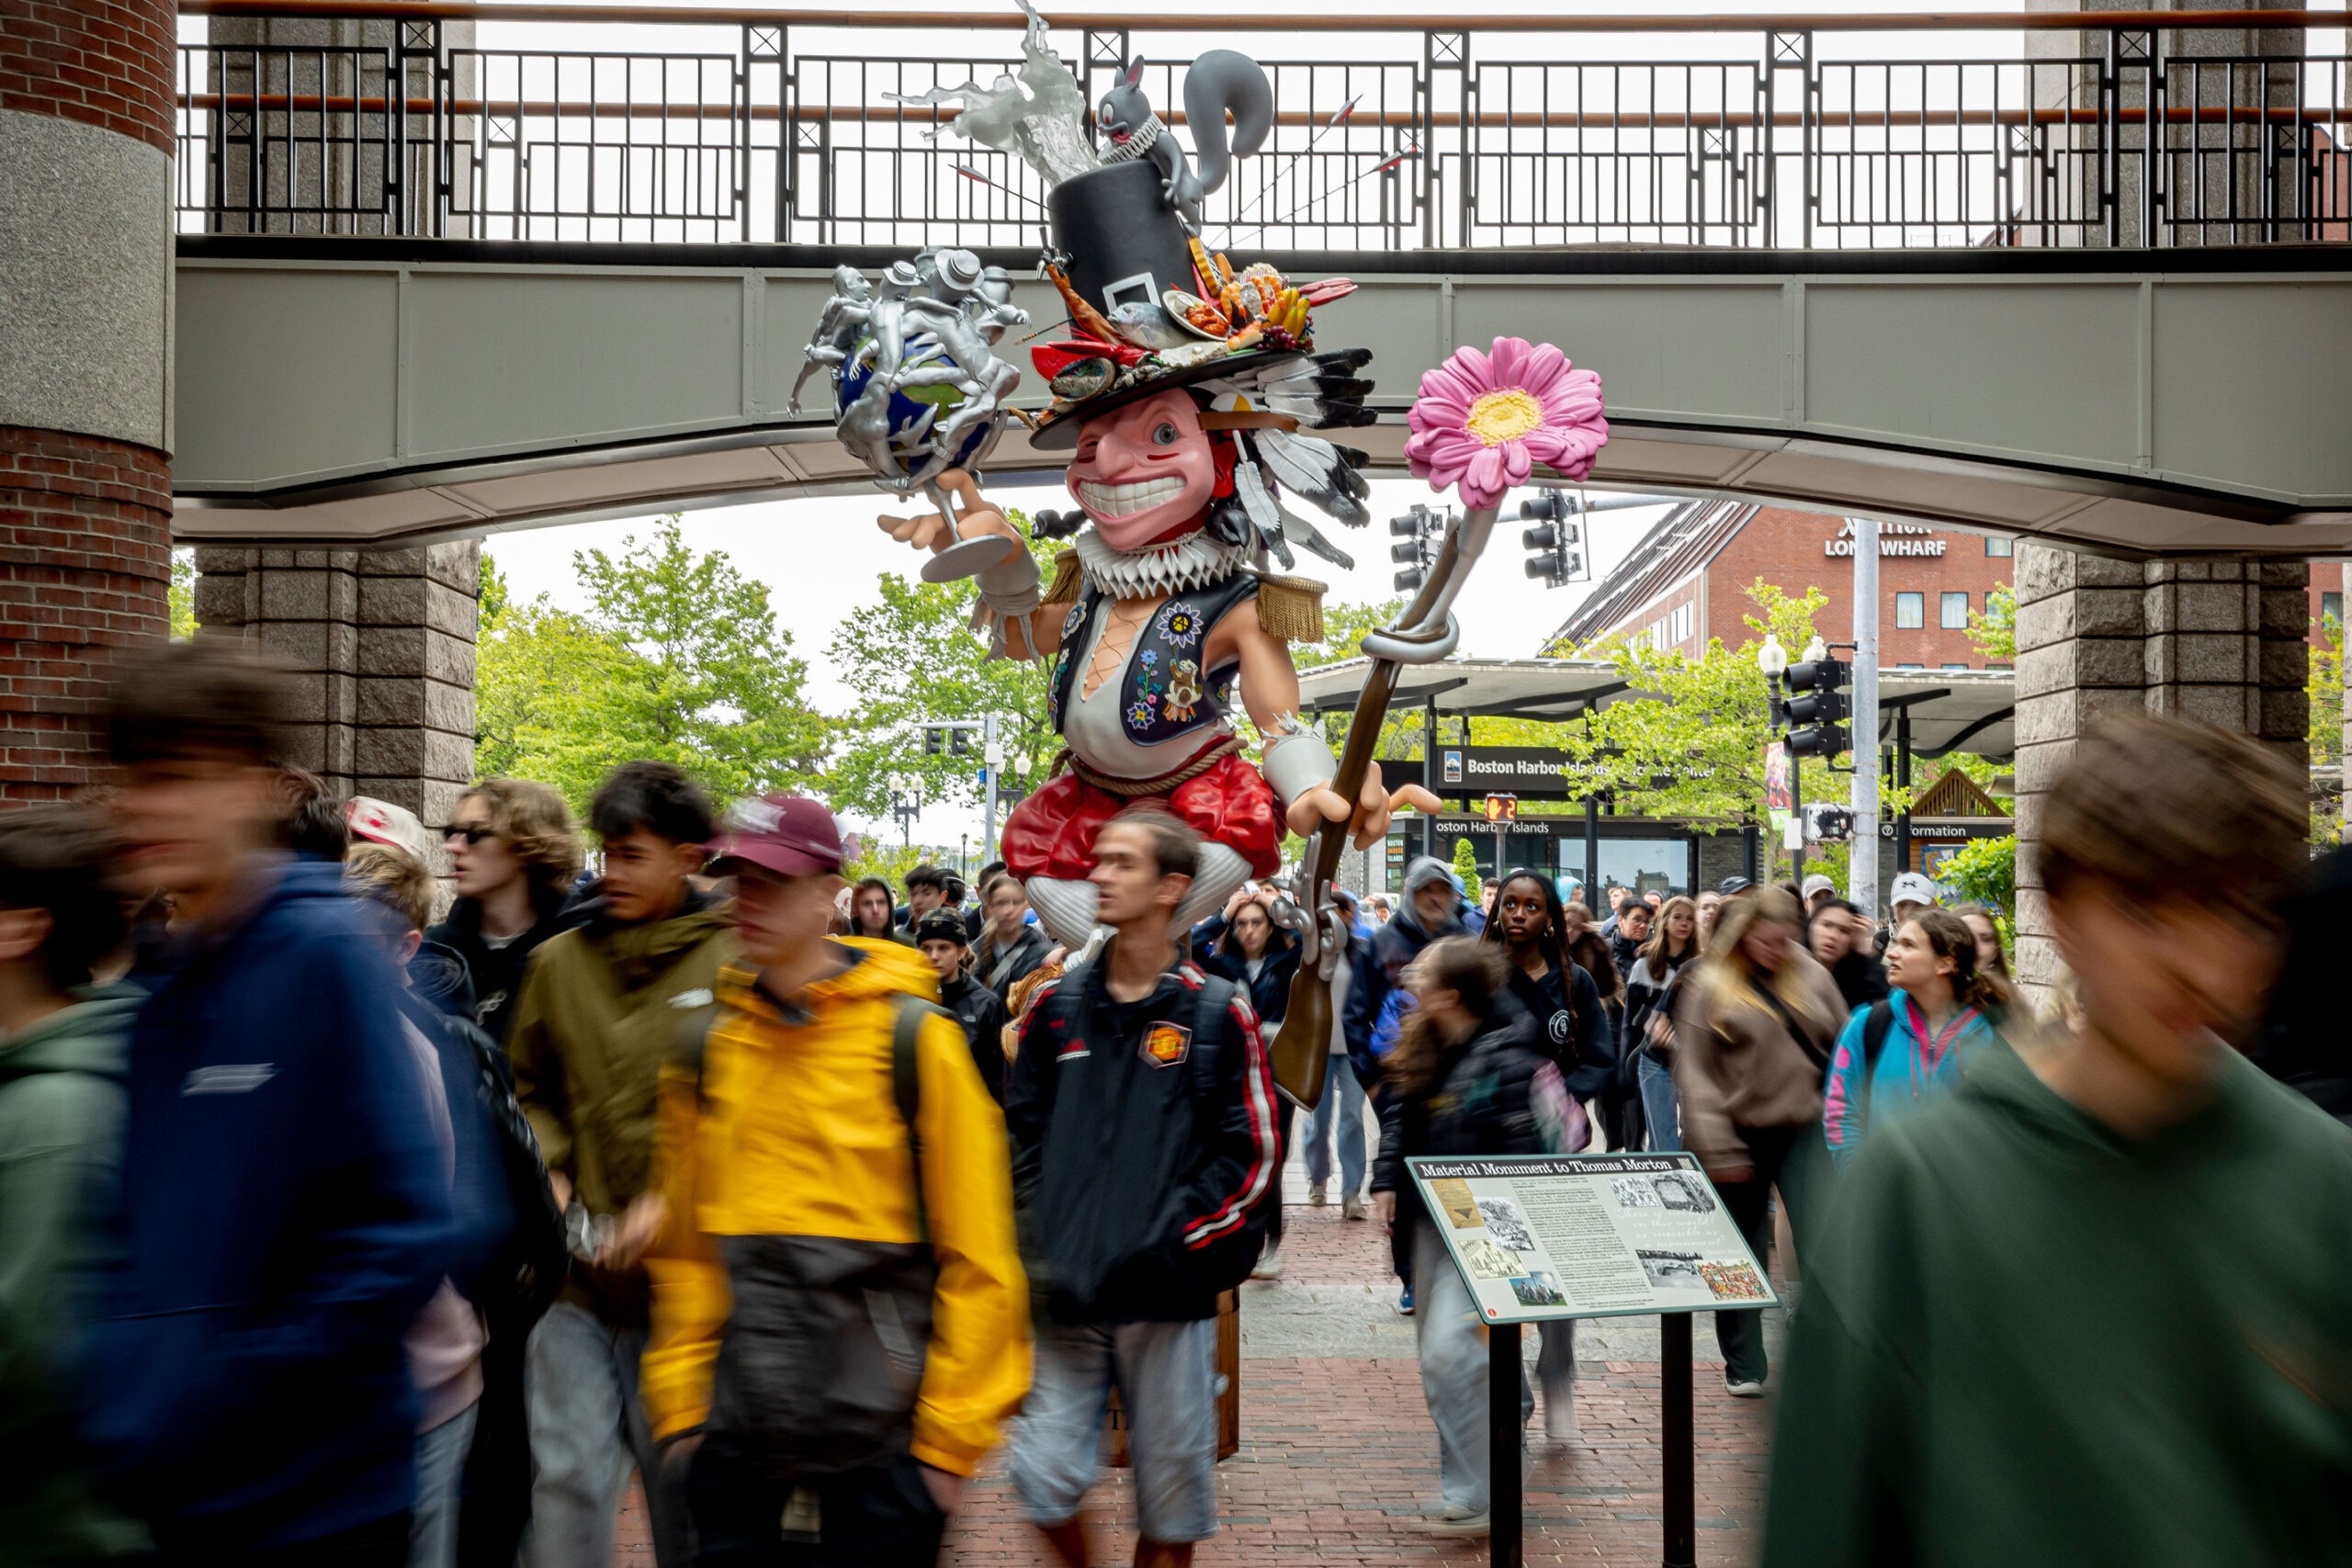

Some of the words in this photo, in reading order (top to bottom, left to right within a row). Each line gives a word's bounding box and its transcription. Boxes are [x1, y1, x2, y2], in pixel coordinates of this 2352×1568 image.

[1880, 540, 1947, 556] WHARF
[1468, 760, 1513, 774] Boston
[1518, 761, 1562, 775] Harbor
[1507, 800, 1515, 819] 2
[1436, 823, 1467, 832] oston
[1513, 822, 1549, 833] Islands
[1420, 1162, 1480, 1178] Material
[1480, 1160, 1554, 1177] Monument
[1554, 1161, 1569, 1173] to
[1567, 1159, 1623, 1173] Thomas
[1620, 1157, 1672, 1171] Morton
